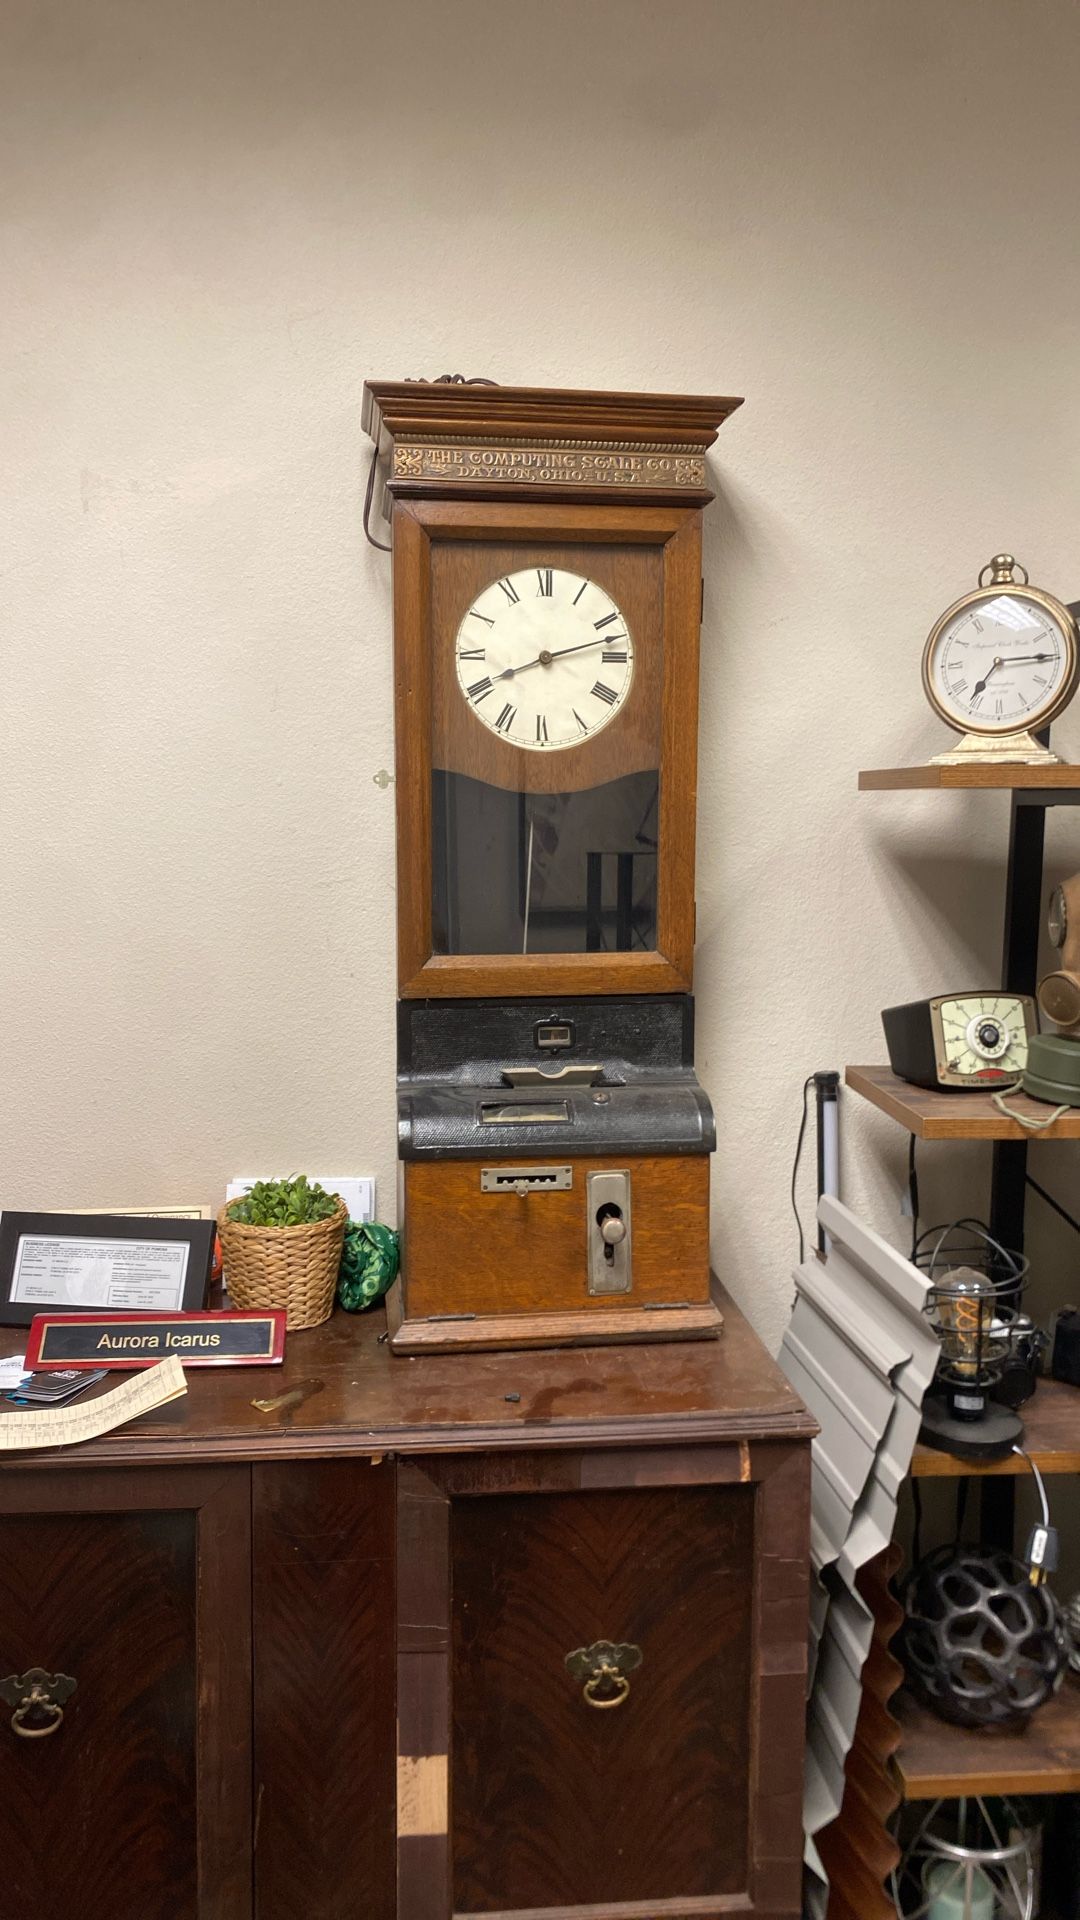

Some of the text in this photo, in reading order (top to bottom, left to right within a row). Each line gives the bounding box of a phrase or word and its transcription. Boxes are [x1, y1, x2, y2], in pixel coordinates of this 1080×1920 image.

[428, 450, 463, 464] THE
[469, 451, 576, 468] COMPUTING
[581, 455, 642, 470] SCALE
[457, 466, 536, 481] DAYTON,
[97, 1332, 221, 1349] Aurora Icarus
